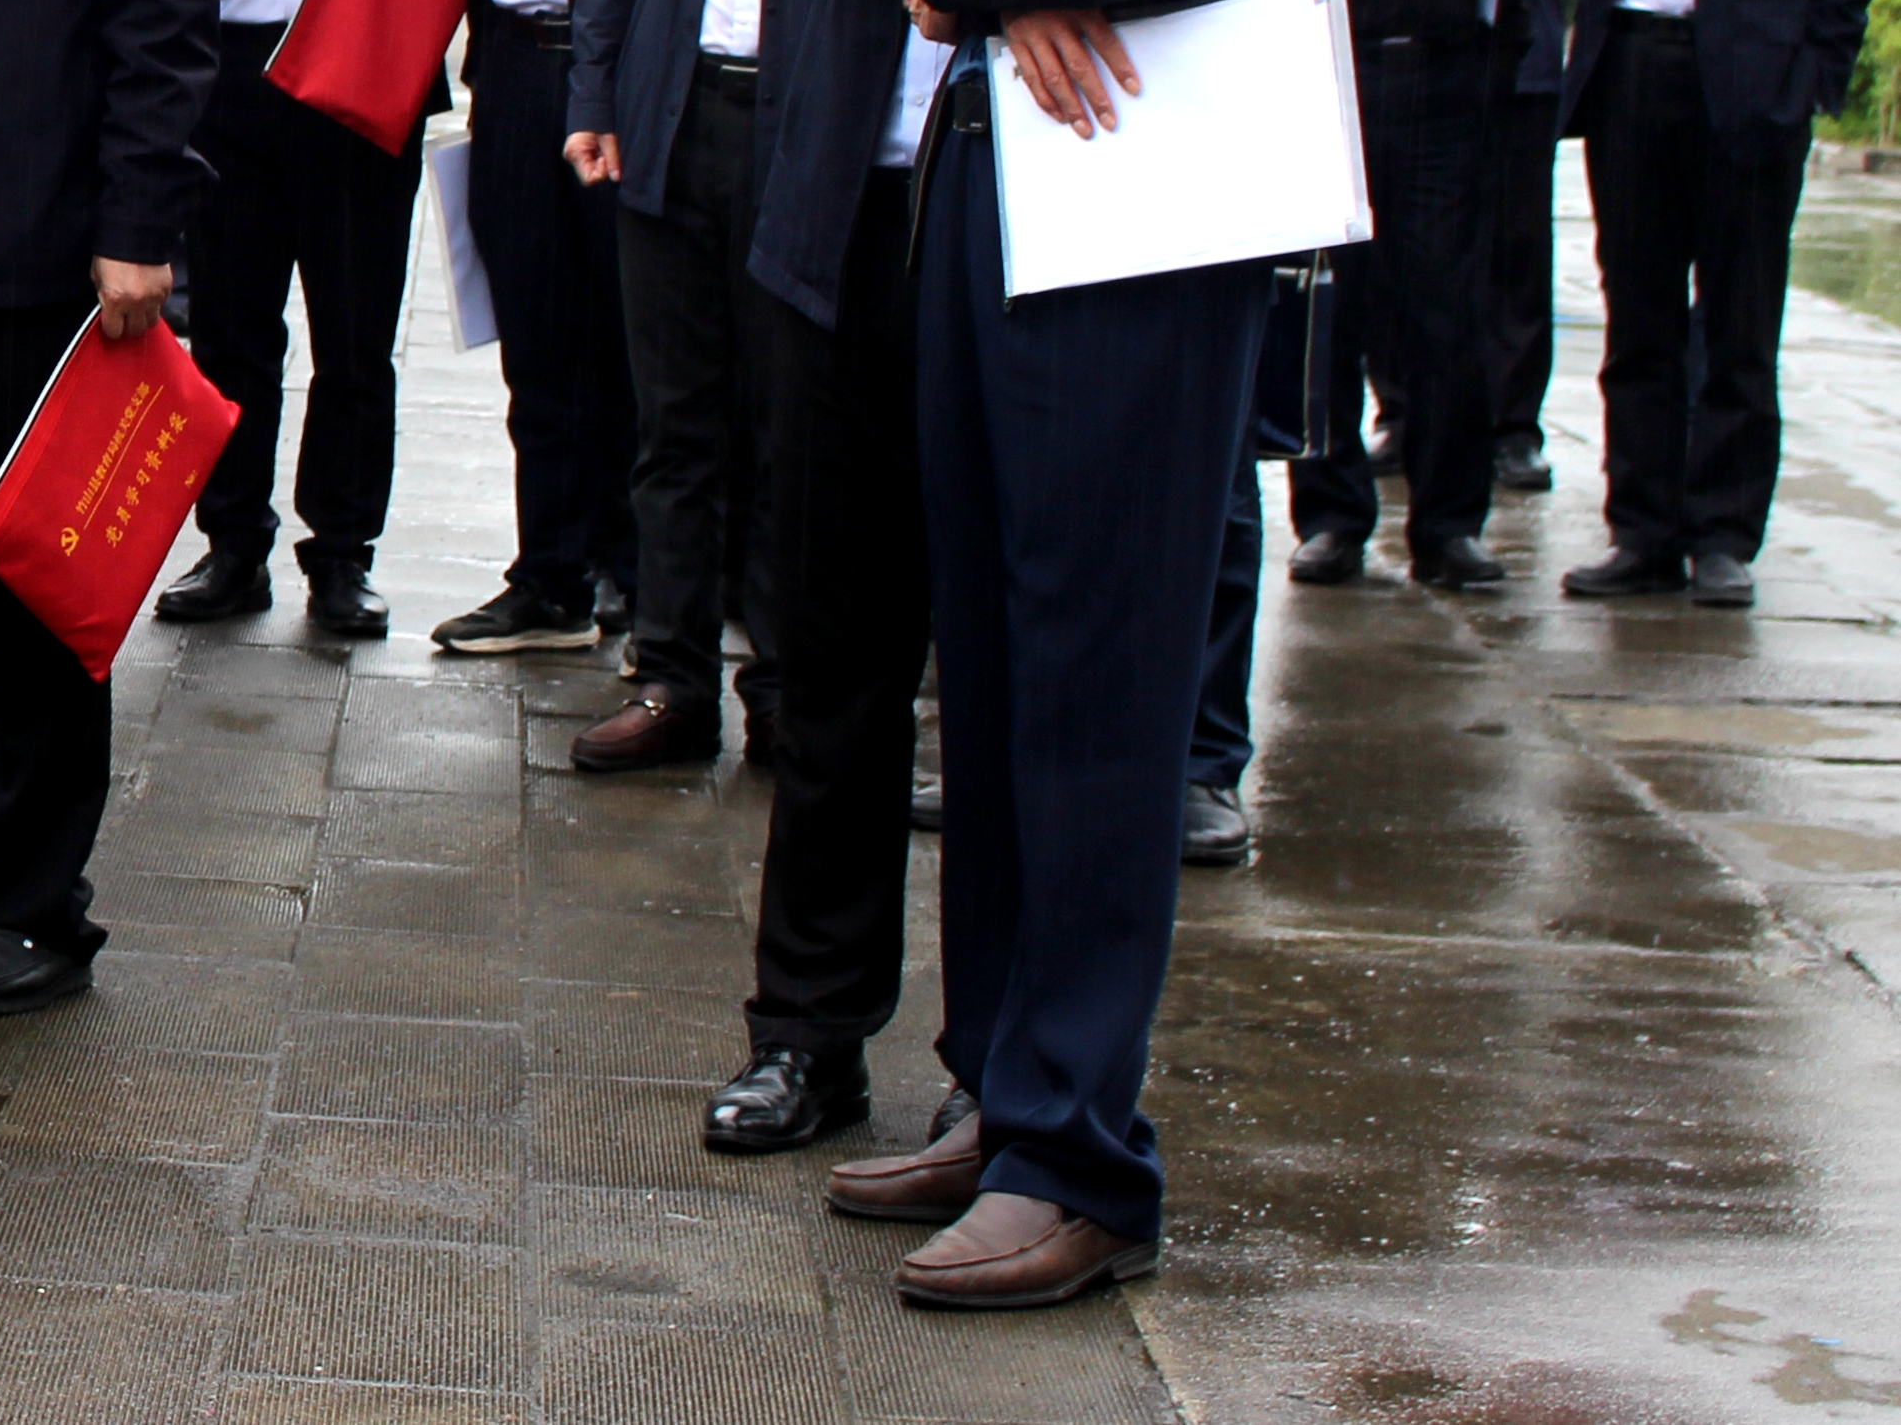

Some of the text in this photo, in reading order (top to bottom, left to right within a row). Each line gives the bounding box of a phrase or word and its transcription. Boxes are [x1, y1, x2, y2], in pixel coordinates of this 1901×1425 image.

[105, 411, 188, 547] 党员学习资料袋
